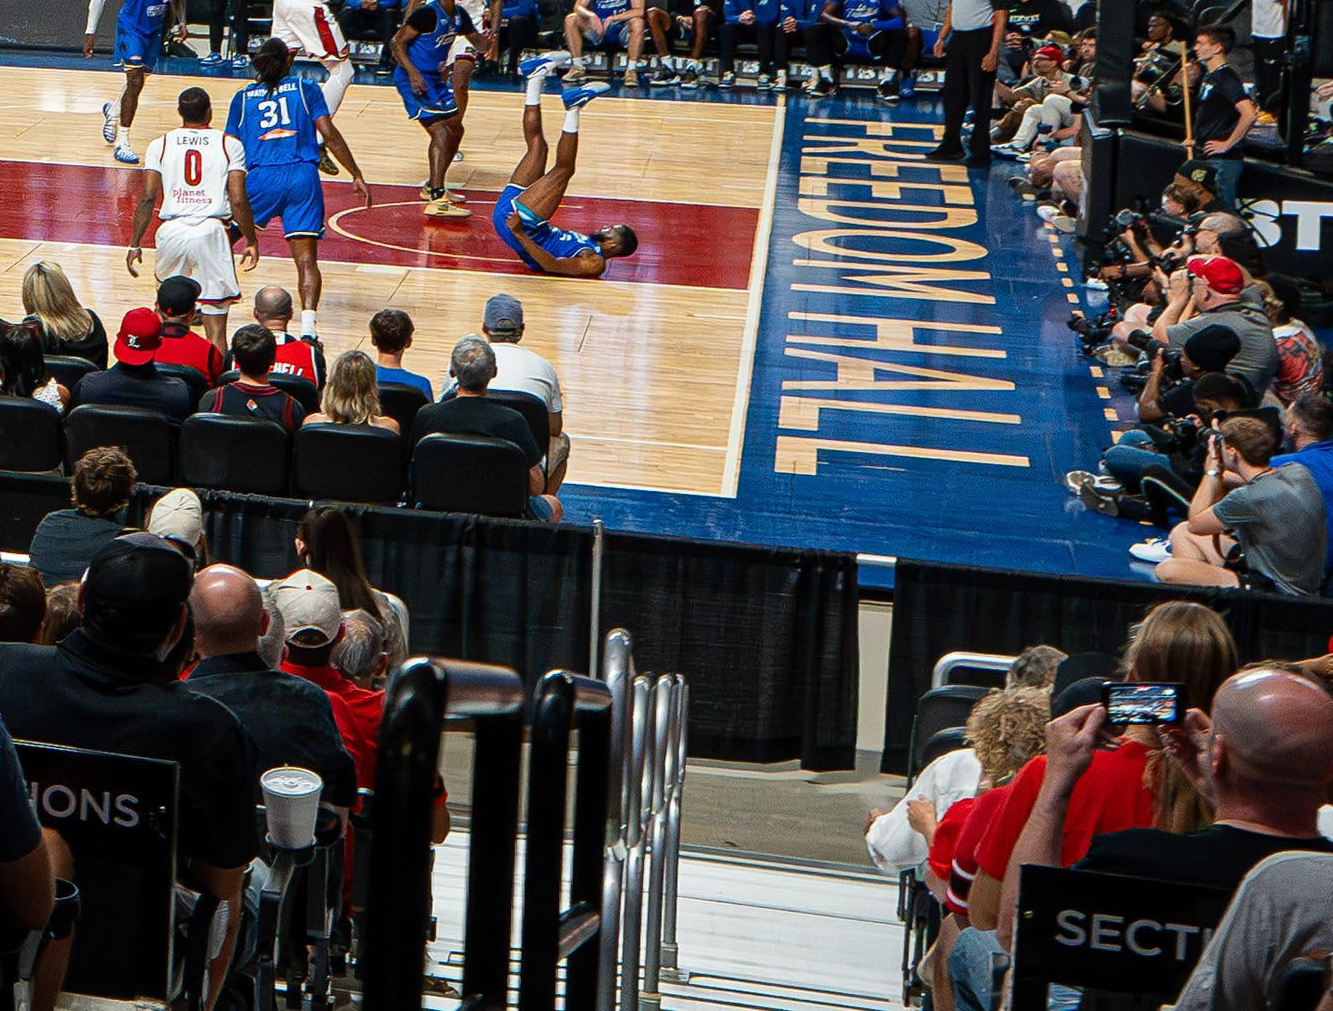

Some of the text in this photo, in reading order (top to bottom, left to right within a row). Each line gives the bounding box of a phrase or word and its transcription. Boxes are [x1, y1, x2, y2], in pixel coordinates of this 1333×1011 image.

[257, 95, 292, 129] 31
[176, 136, 210, 146] LEWIS
[184, 148, 203, 187] 0
[172, 188, 206, 198] planet
[774, 116, 1031, 476] FREEDOM HALL
[127, 334, 141, 349] L
